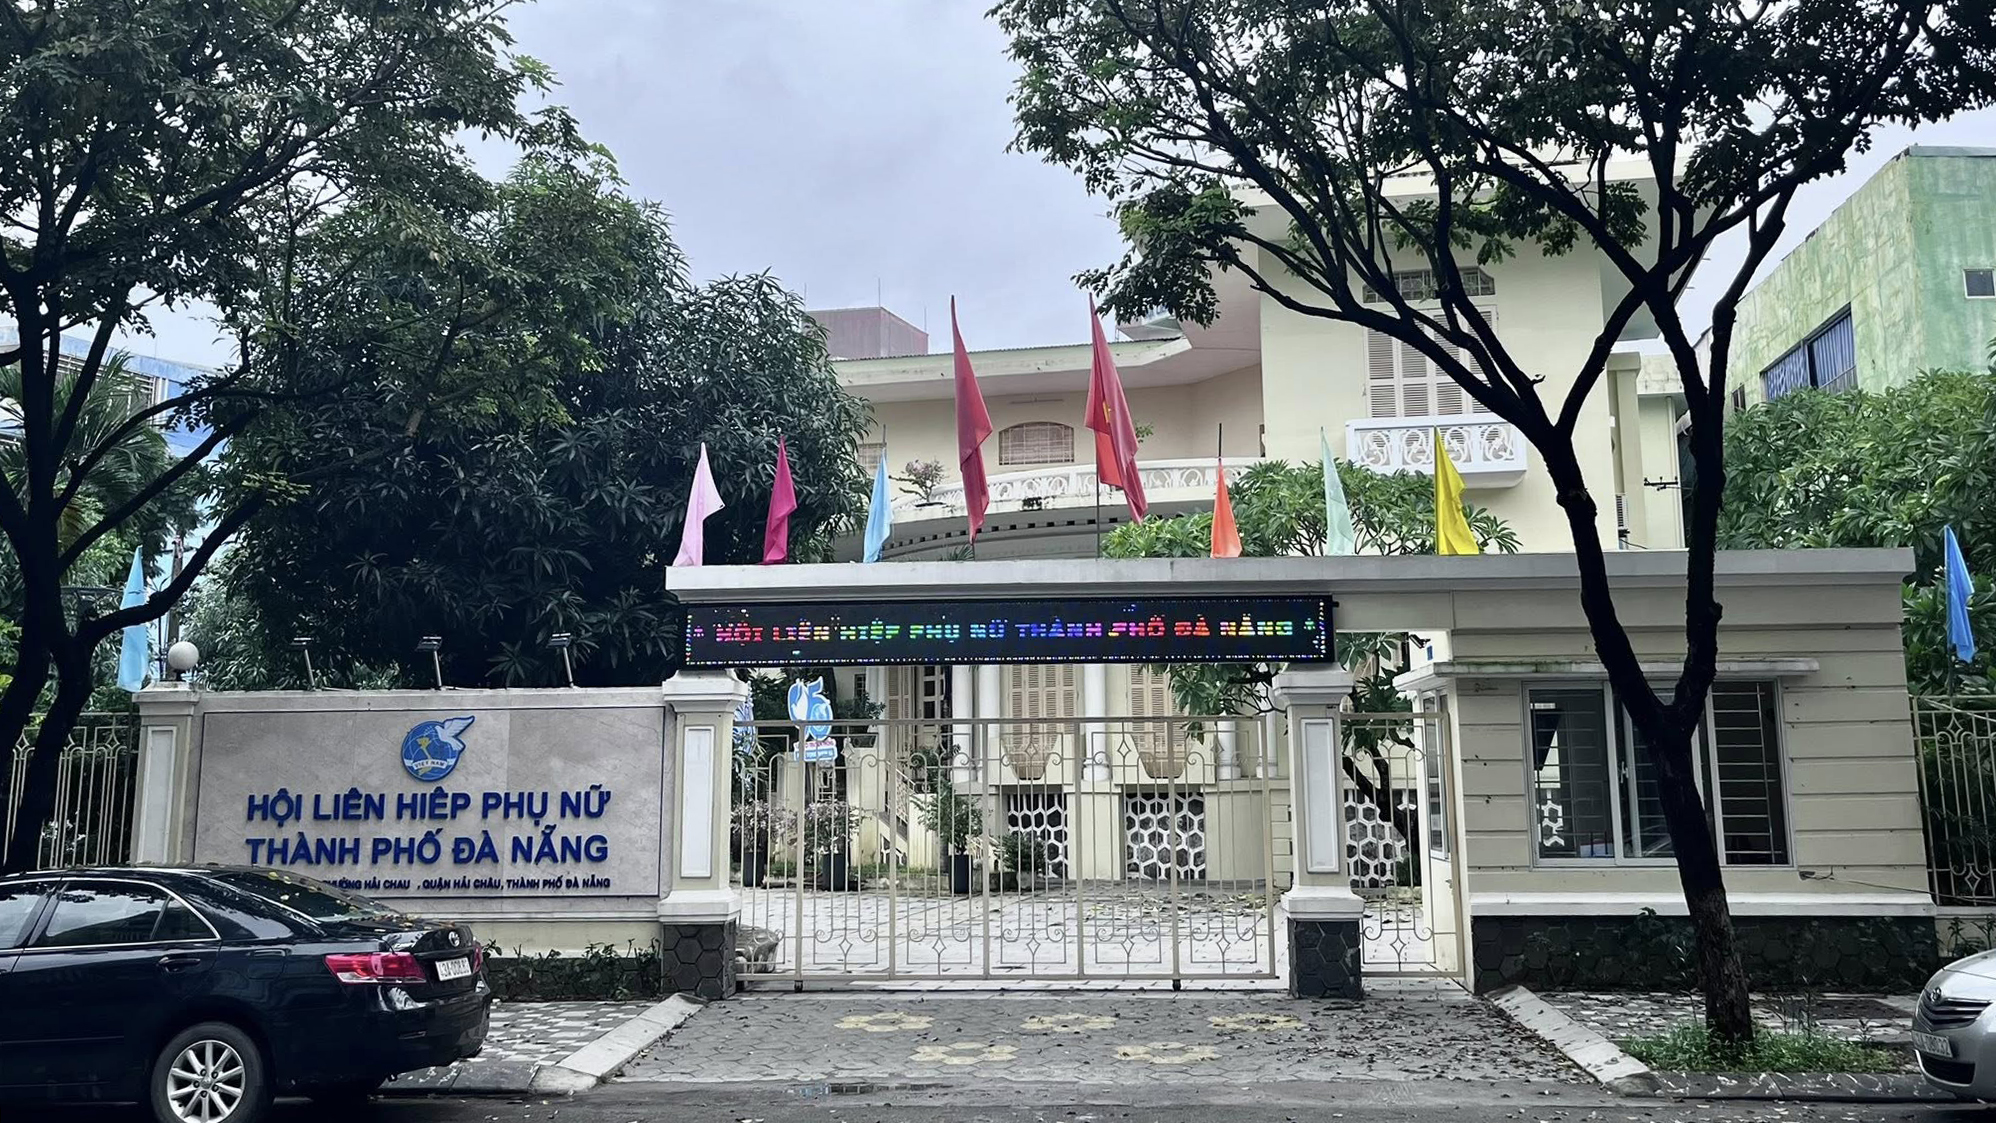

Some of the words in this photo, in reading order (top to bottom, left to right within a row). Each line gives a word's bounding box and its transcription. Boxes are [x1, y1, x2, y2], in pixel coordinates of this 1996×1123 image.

[1174, 614, 1210, 636] ĐÀ
[247, 788, 303, 828] HỘI
[313, 787, 386, 821] LIÊN
[481, 791, 549, 826] PHỤ
[560, 784, 611, 818] NỮ
[245, 831, 361, 865] THÀNH
[371, 828, 443, 865] PHỐ
[451, 829, 499, 864] ĐÀ
[511, 824, 609, 864] NẴNG
[453, 875, 471, 889] HẢI
[506, 876, 540, 889] THÀNH
[542, 875, 563, 889] PHỐ
[565, 876, 580, 889] ĐÀ
